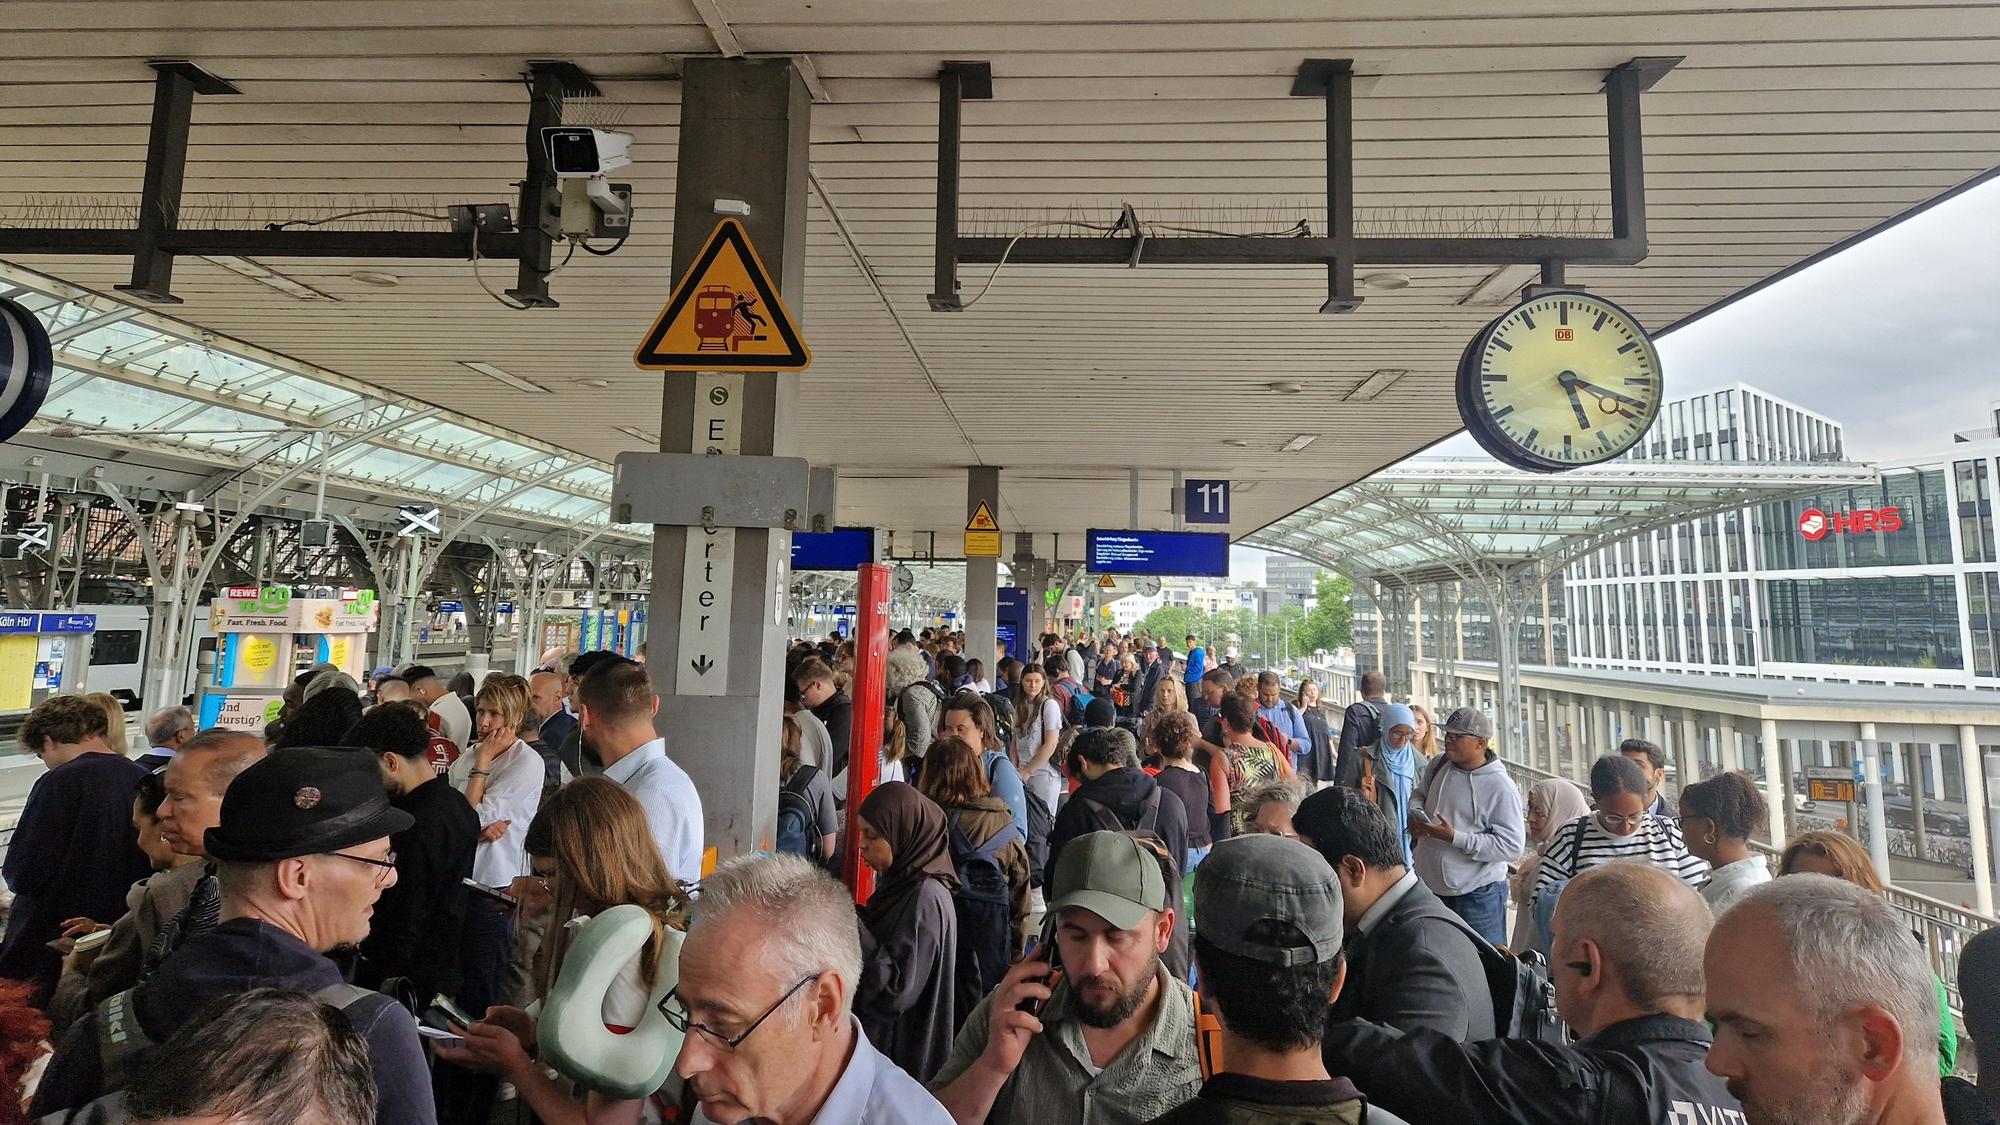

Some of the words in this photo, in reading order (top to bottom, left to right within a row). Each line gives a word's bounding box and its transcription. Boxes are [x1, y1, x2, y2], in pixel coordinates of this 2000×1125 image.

[1557, 330, 1572, 340] DB
[1197, 483, 1224, 514] 11
[1833, 506, 1902, 534] HRS
[229, 588, 258, 599] REWE
[17, 616, 33, 627] Hbf
[218, 701, 240, 712] Und
[216, 714, 261, 727] durstig?
